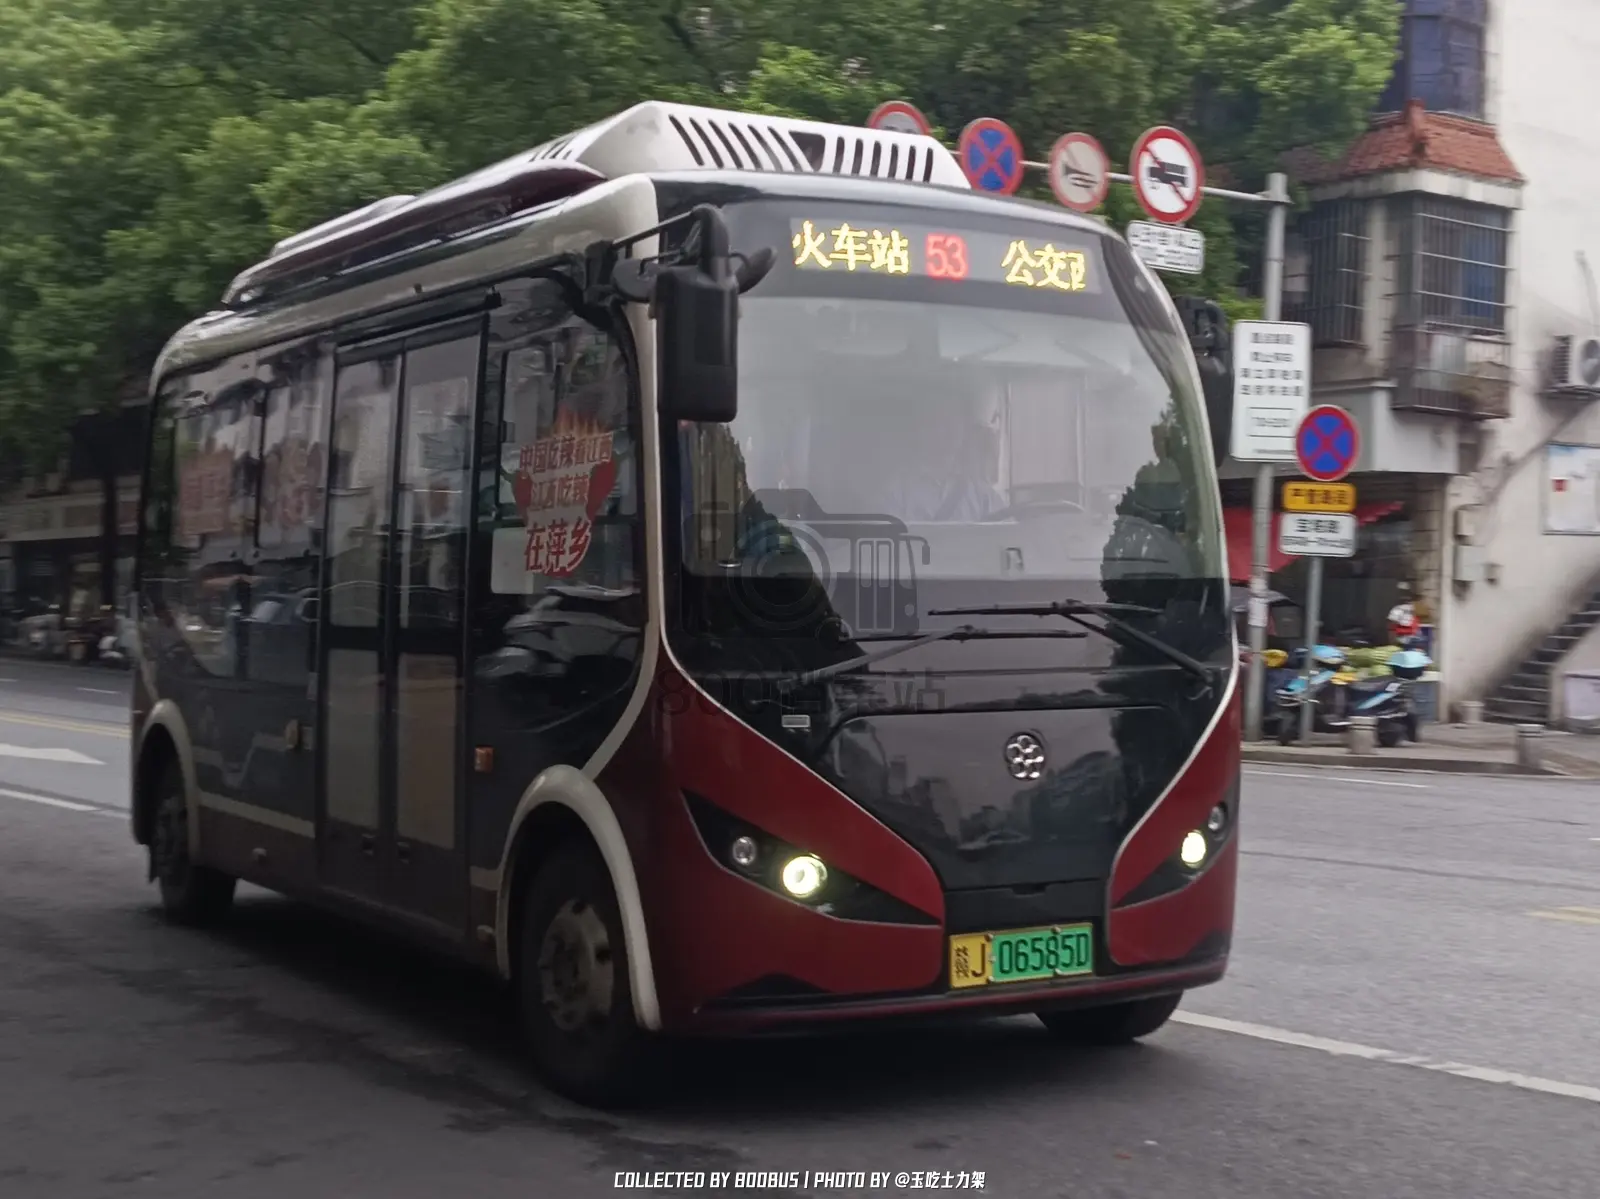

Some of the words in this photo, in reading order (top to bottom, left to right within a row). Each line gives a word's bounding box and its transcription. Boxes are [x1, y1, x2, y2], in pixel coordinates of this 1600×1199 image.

[792, 220, 908, 274] 火车站
[924, 234, 968, 279] 53
[524, 516, 590, 573] 在萍乡
